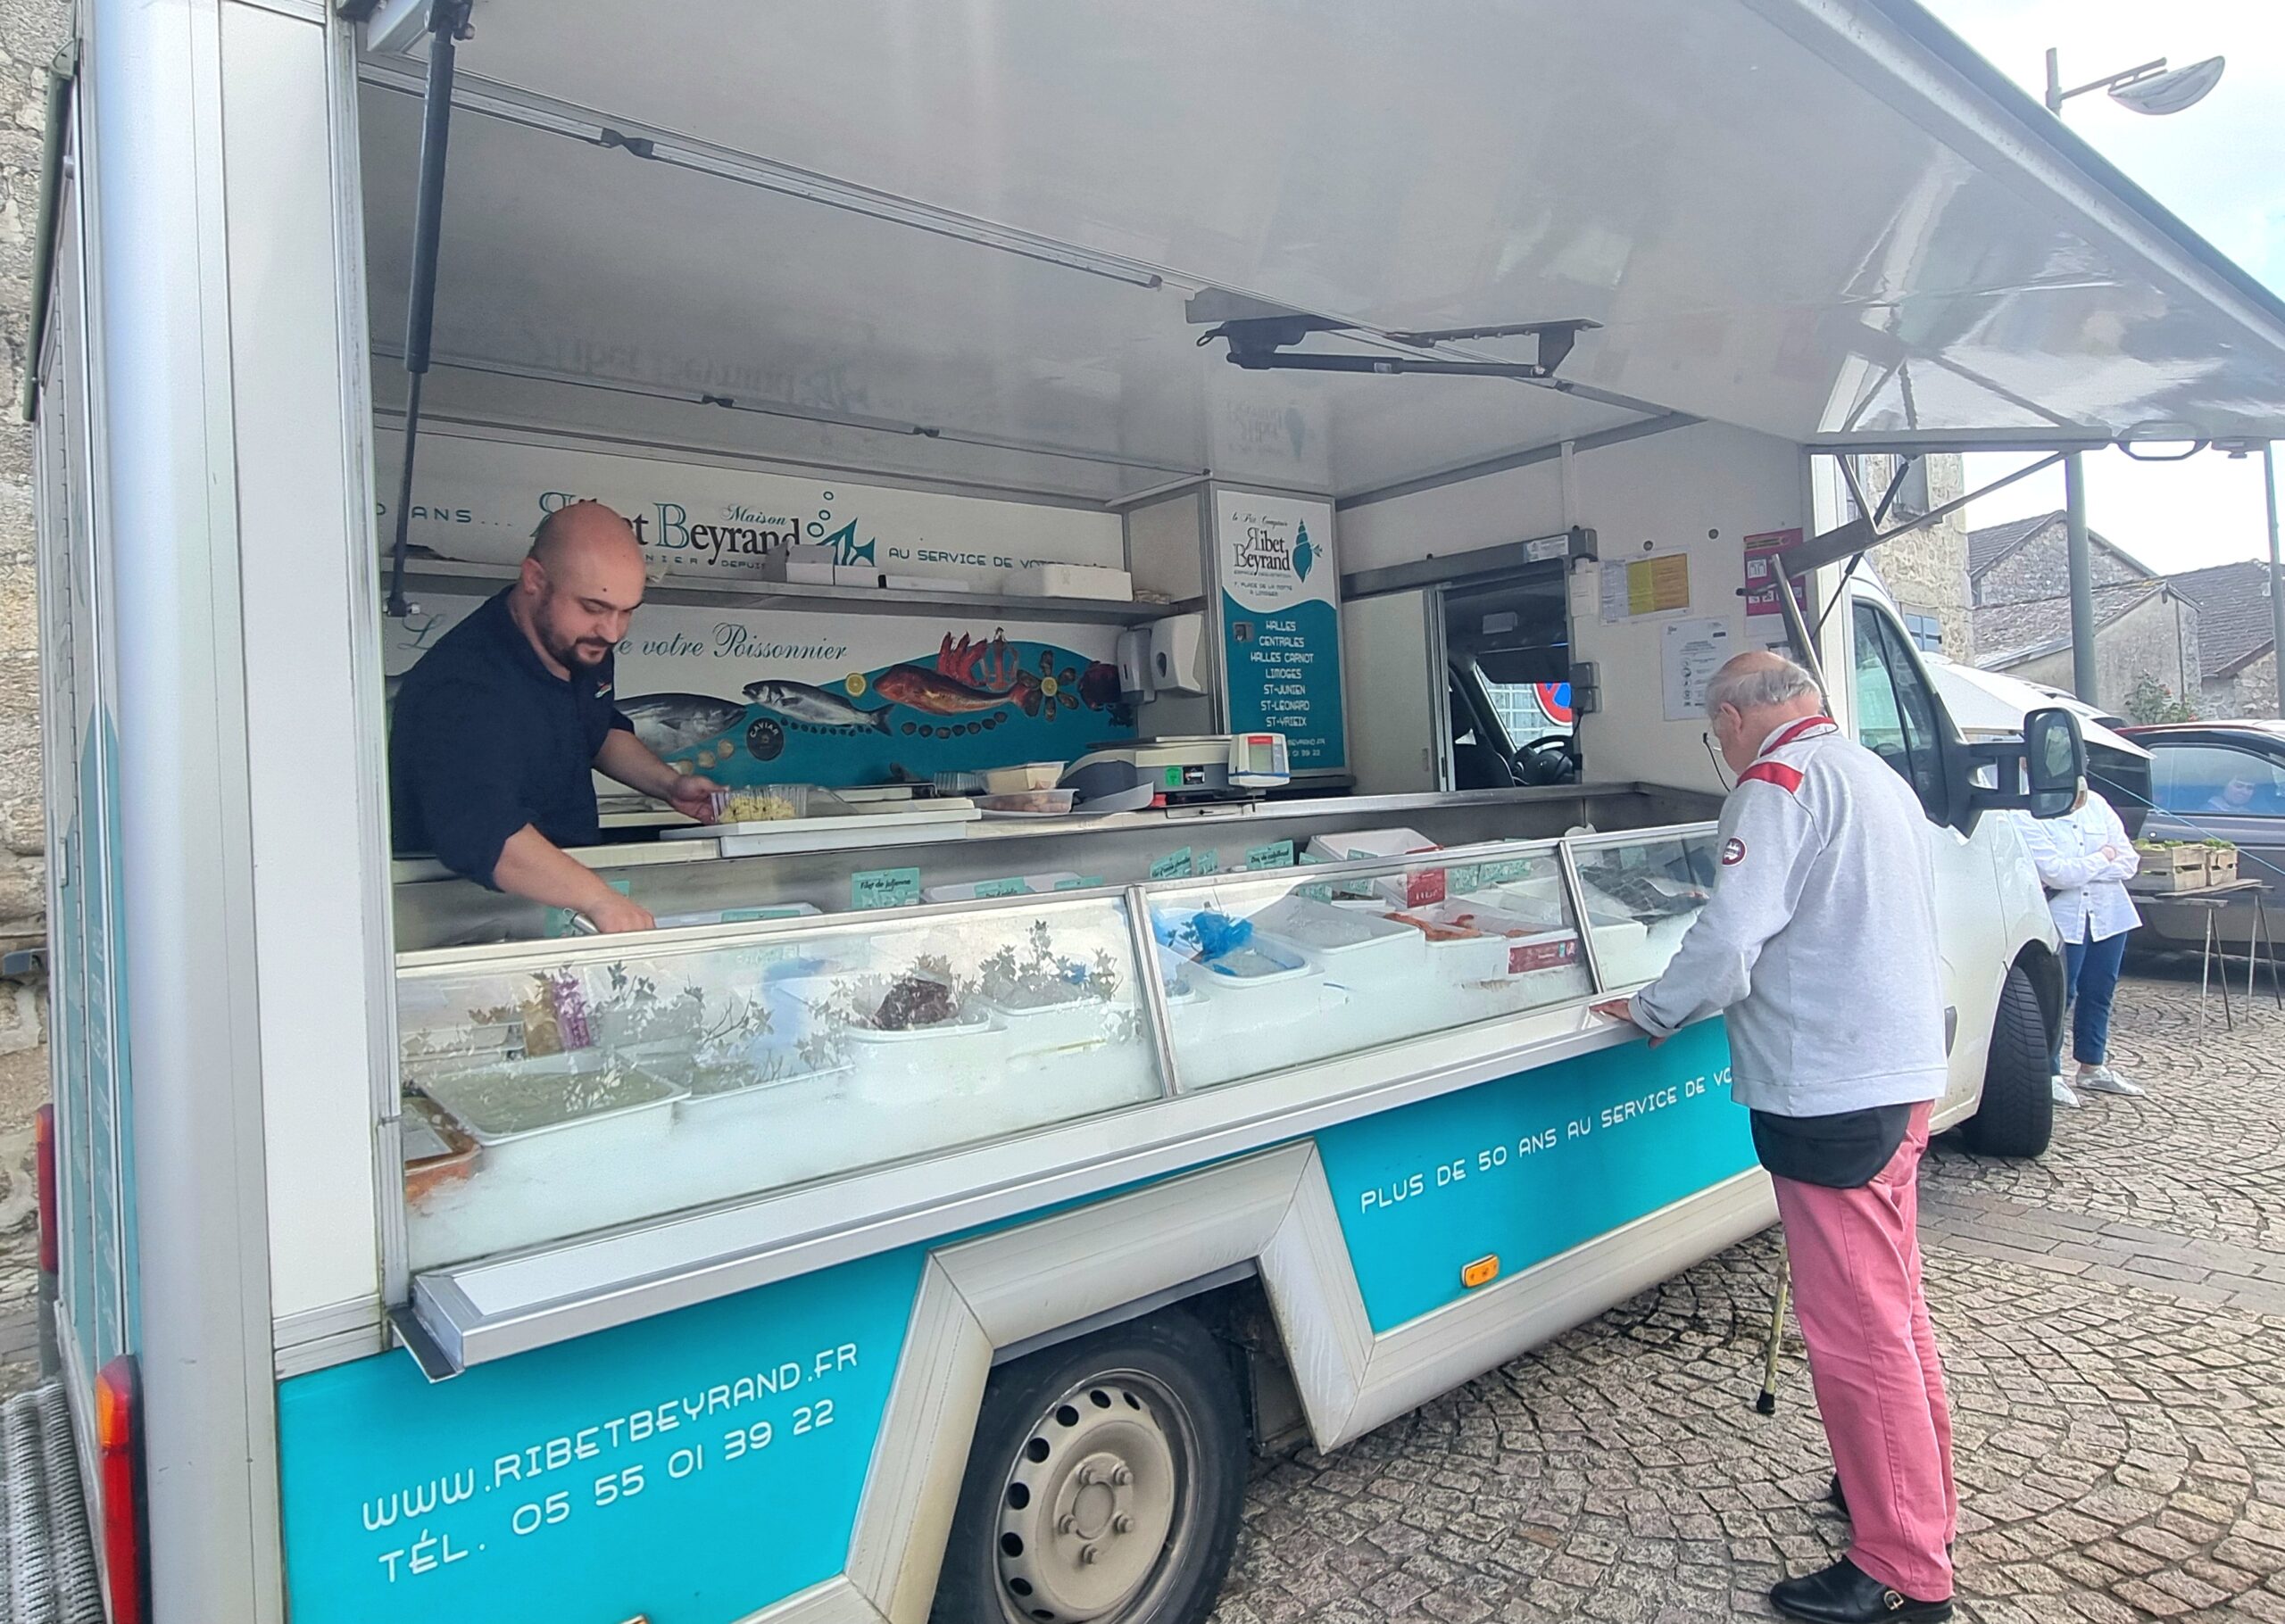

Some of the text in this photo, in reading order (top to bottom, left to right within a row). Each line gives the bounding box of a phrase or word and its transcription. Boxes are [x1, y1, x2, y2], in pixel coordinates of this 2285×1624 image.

[722, 503, 788, 526] Maison
[653, 502, 800, 566] Beyrand
[1245, 527, 1285, 553] Ribet
[888, 547, 910, 559] AU
[917, 550, 986, 567] SERVICE
[993, 556, 1013, 568] DE
[1233, 543, 1291, 576] Beyrand
[1266, 620, 1297, 632] HALLES
[642, 633, 704, 658] votre
[712, 622, 847, 659] Poissonnier
[1259, 635, 1305, 648] CENTRALES
[1250, 651, 1315, 663] HALLES CARNOT
[1265, 668, 1302, 680] LIMOGES
[1263, 684, 1306, 695] ST-JUNIEN
[1260, 700, 1310, 711] ST-LEONARD
[749, 721, 779, 739] CAVIAR
[1266, 717, 1308, 727] ST-YRIEIX
[1359, 1066, 1733, 1215] PLUS DE 50 ANS AU SERVICE DE VO
[361, 1342, 859, 1533] WWW.RIBETBEYRAND.FR
[378, 1398, 835, 1584] TÉL. 05 55 01 39 22
